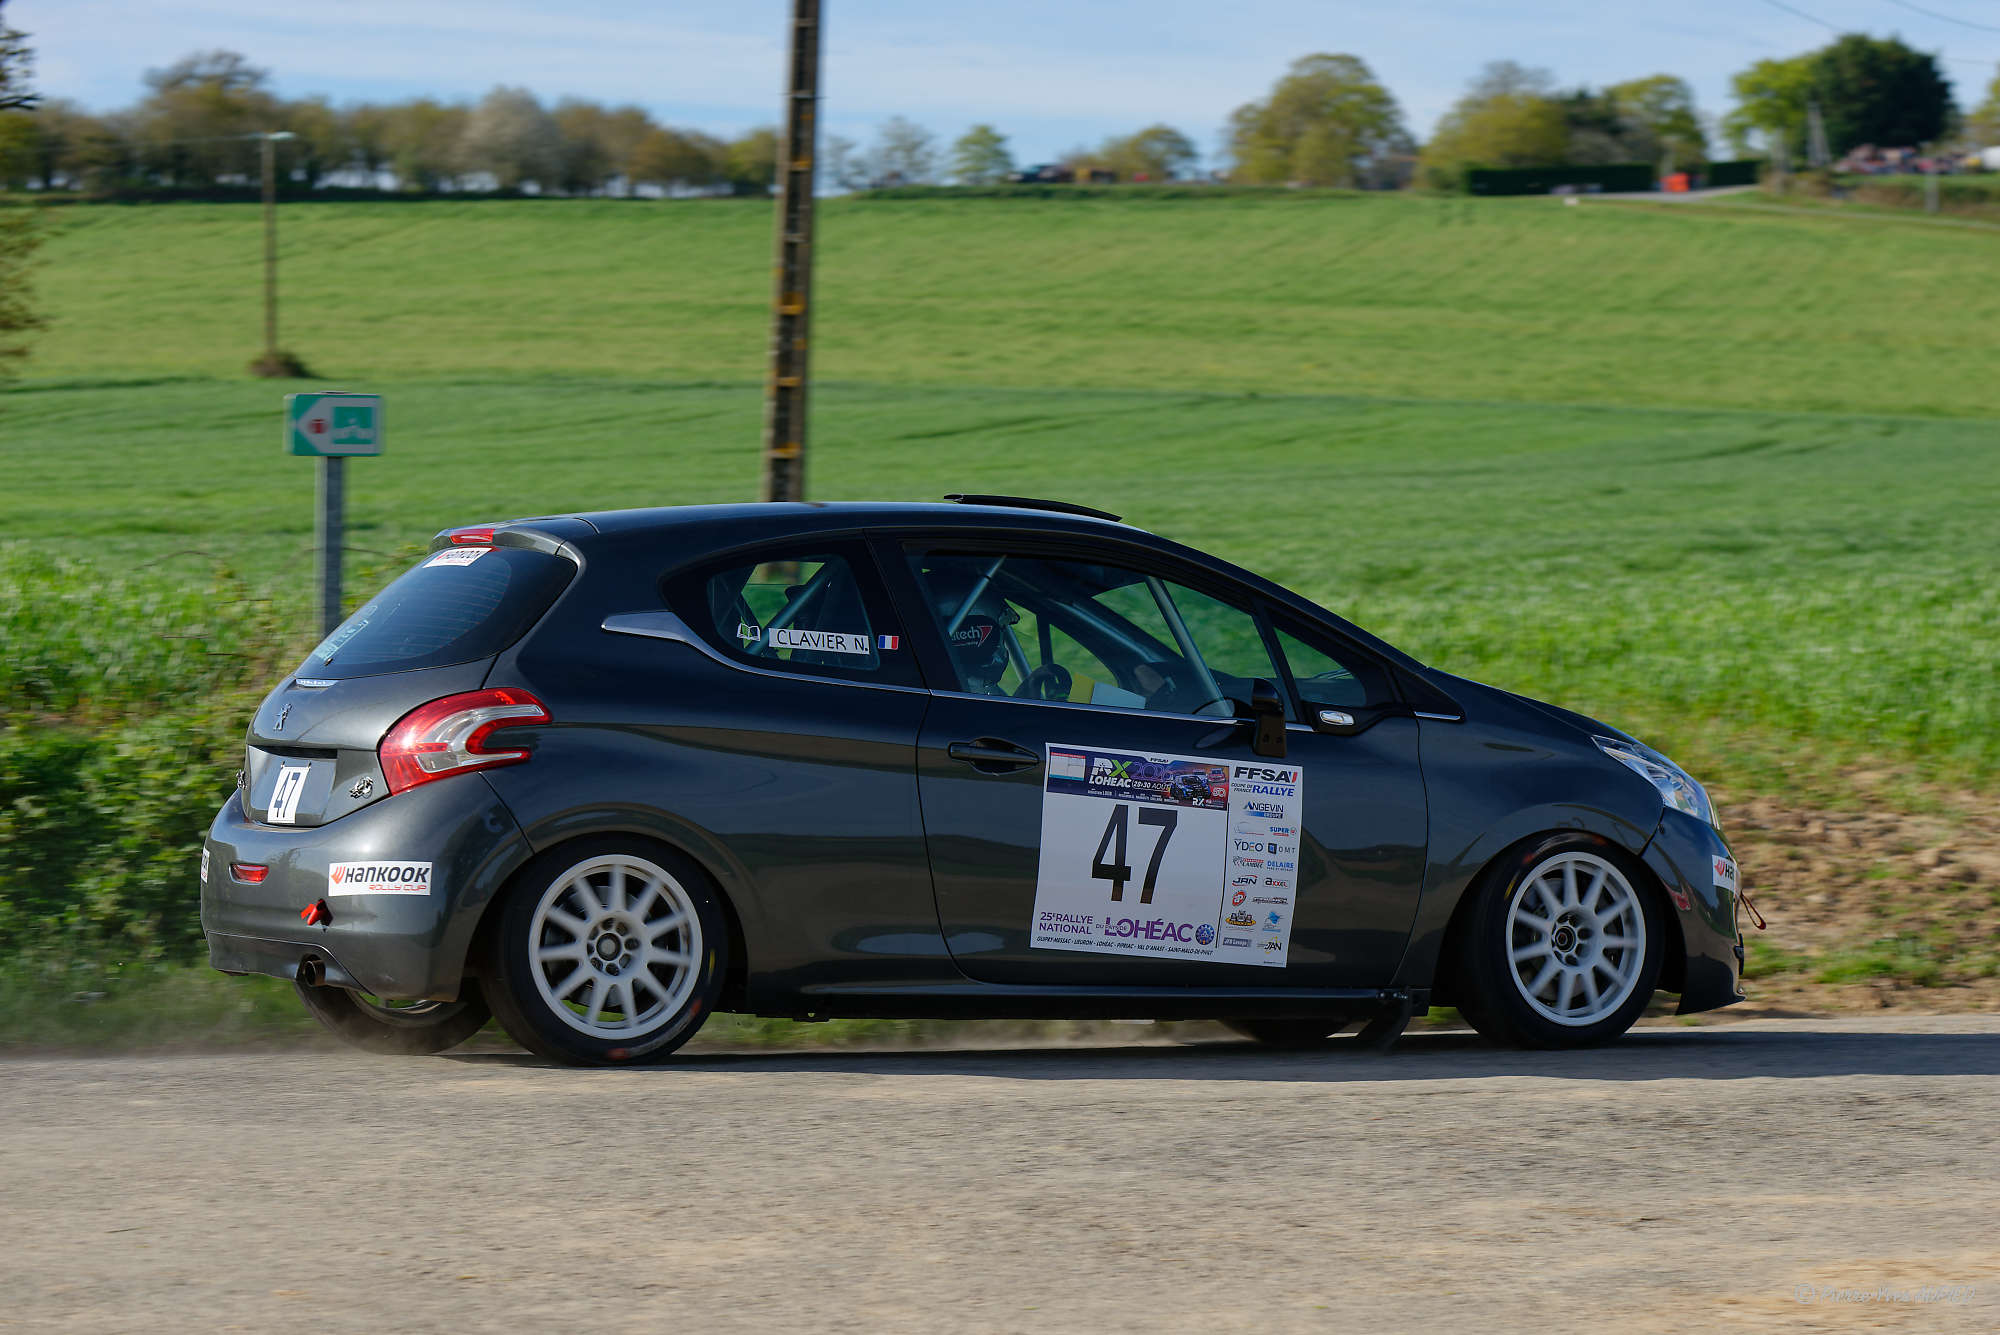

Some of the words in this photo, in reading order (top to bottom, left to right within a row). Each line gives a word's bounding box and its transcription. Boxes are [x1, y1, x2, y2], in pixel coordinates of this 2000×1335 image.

[777, 630, 846, 650] CLAVIER
[854, 637, 869, 652] N.
[1092, 757, 1132, 778] RX
[1089, 775, 1132, 788] LOHEAC
[1234, 767, 1290, 783] FFSA
[274, 771, 301, 818] 47
[1252, 784, 1295, 797] RALLYE
[1269, 826, 1290, 834] SUPER
[1234, 841, 1264, 852] YDEO
[1091, 803, 1178, 905] 47
[1055, 913, 1094, 925] RALLYE
[1039, 922, 1093, 935] NATIONAL
[1104, 917, 1194, 943] LOHÉAC
